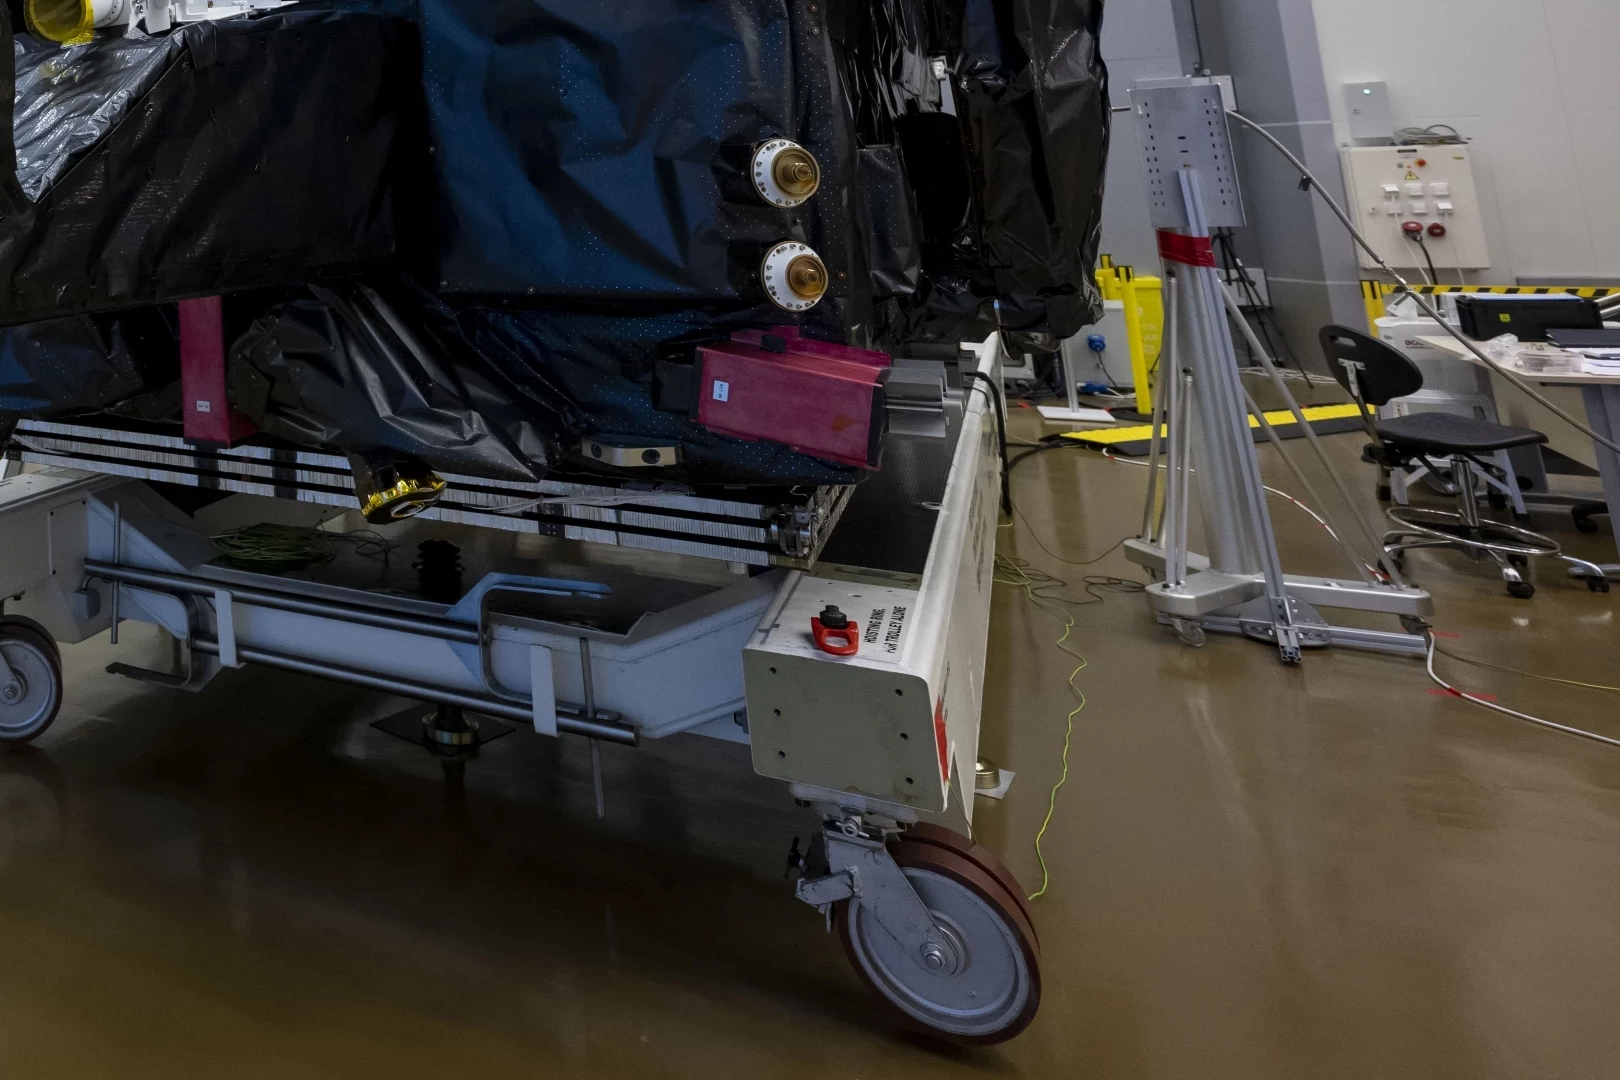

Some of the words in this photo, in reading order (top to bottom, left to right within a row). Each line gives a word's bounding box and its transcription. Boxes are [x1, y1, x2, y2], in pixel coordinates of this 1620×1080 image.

[891, 606, 906, 621] ALONE
[863, 621, 881, 643] HOISTING
[885, 621, 902, 642] TROLLEY
